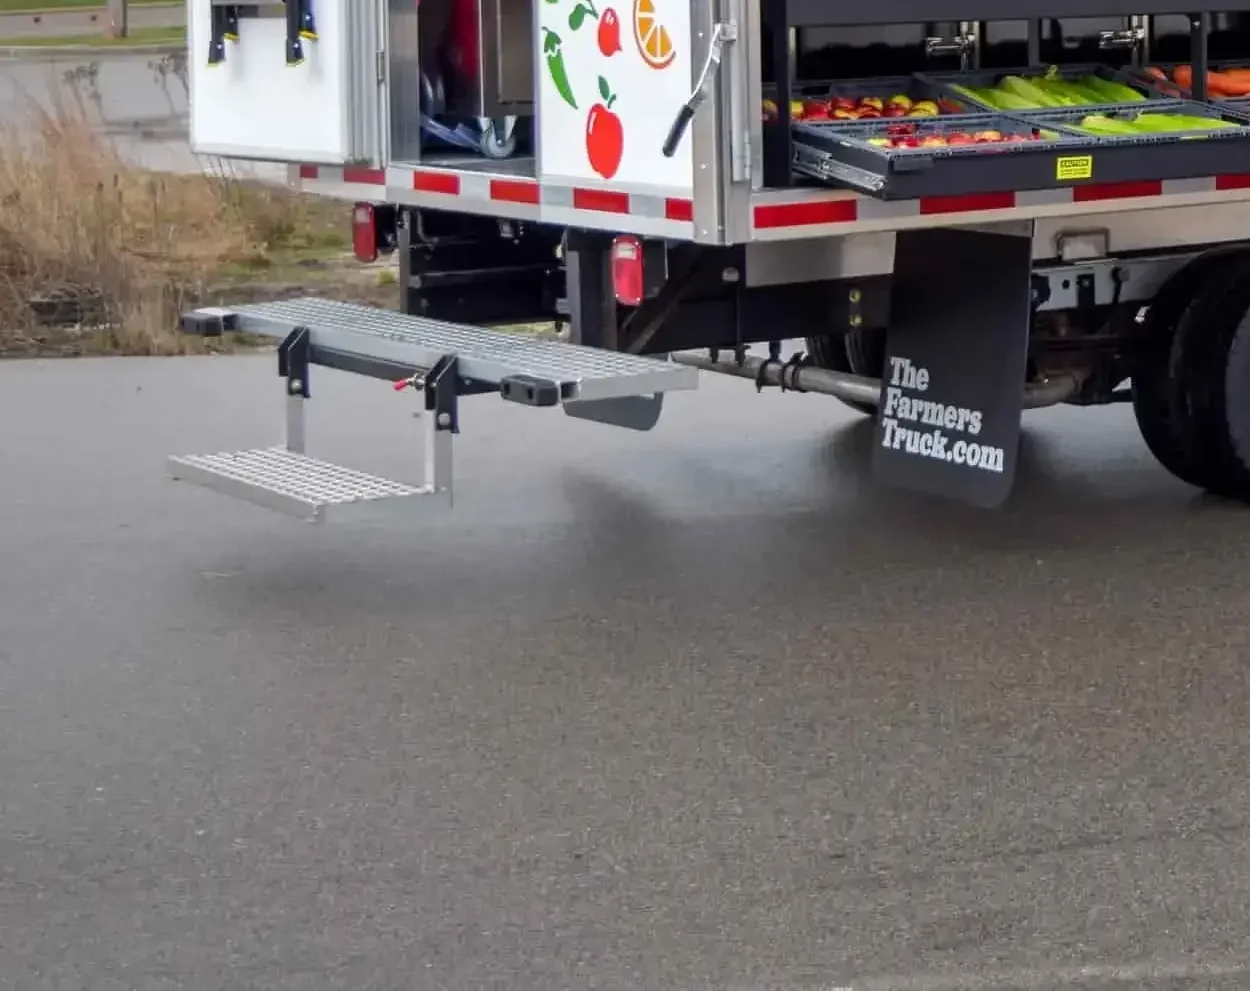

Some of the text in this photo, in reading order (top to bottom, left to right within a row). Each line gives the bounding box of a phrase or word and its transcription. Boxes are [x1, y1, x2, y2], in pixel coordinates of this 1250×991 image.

[890, 356, 929, 391] The
[884, 386, 983, 434] Farmers
[882, 417, 1004, 473] Truck.com
